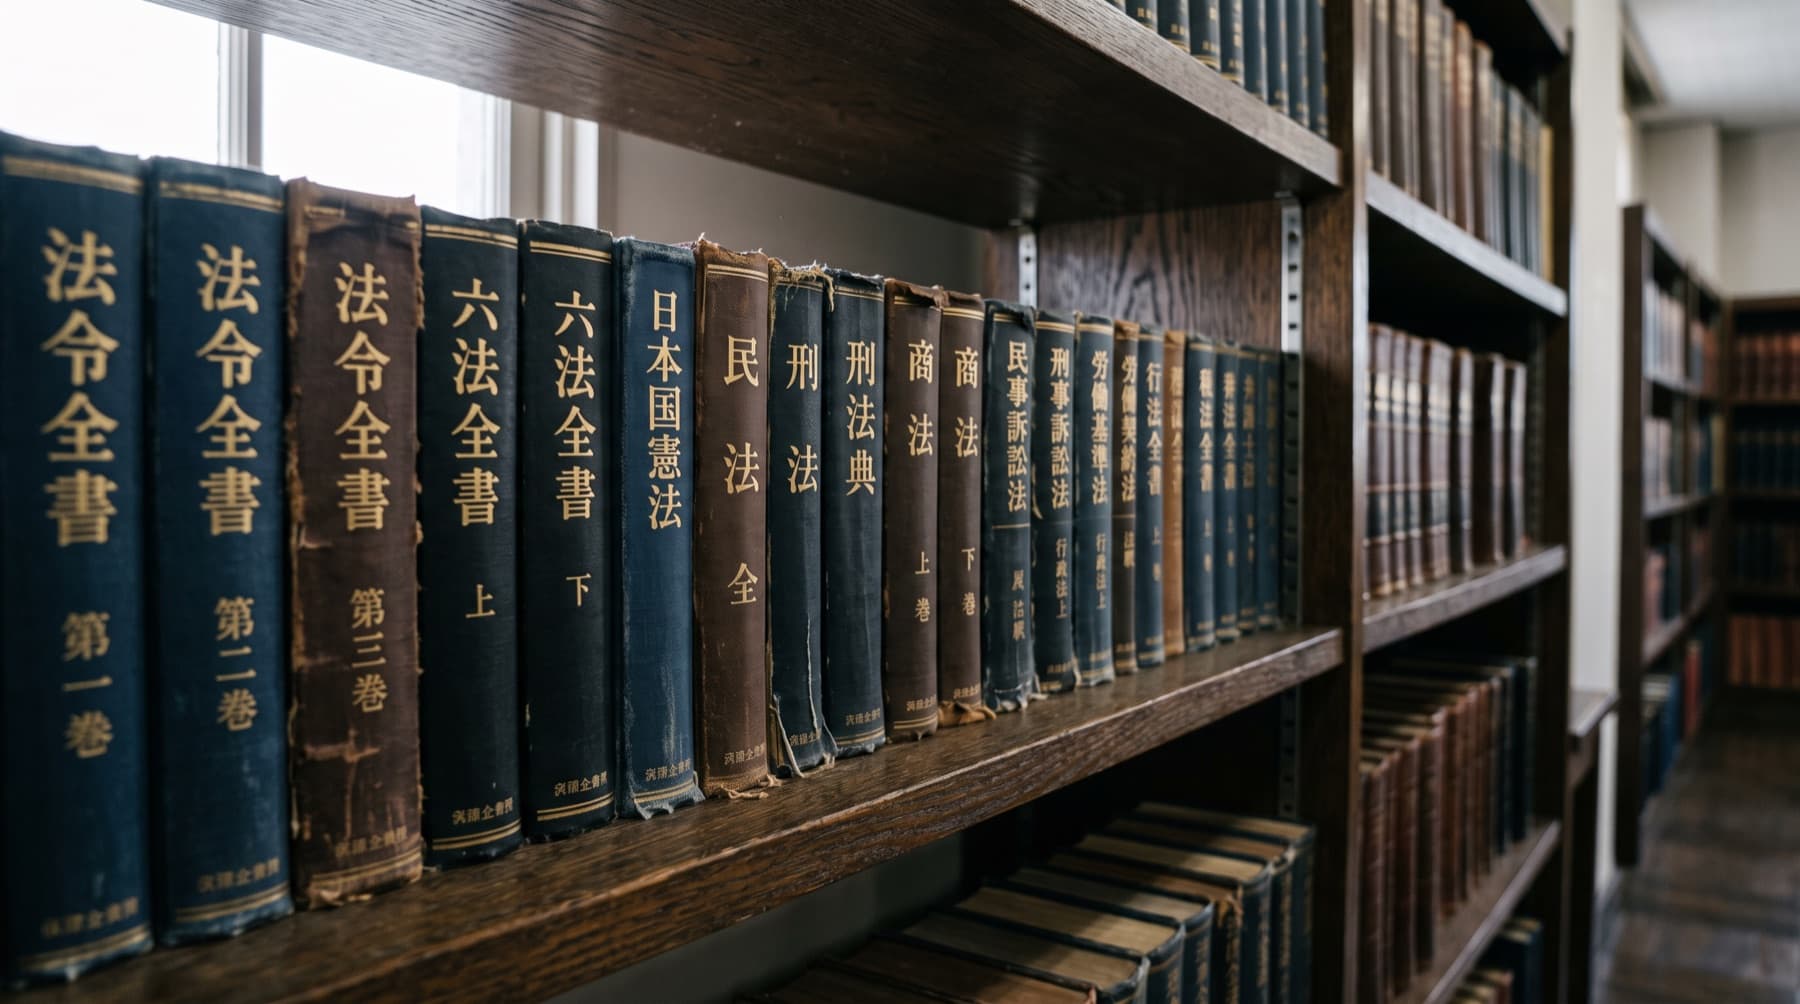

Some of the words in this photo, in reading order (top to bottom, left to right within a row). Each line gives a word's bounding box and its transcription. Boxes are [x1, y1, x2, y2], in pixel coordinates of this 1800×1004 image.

[40, 226, 120, 547] 法令全書
[195, 243, 263, 536] 法令全書
[333, 261, 392, 532] 法令全書
[451, 278, 500, 526] 六法全書
[554, 290, 597, 520] 六法全書
[646, 289, 683, 530] 日本国憲法
[846, 341, 876, 496] 刑法典
[908, 338, 934, 457] 商法
[955, 346, 979, 457] 商法
[1007, 340, 1029, 512] 民事訴訟法
[1050, 348, 1070, 510] 刑事訴訟法
[349, 587, 389, 713] 第三巻
[465, 584, 496, 619] 上
[566, 573, 592, 607] 下
[727, 562, 759, 605] 全
[62, 611, 113, 759] 第一巻
[213, 596, 258, 732] 第二巻
